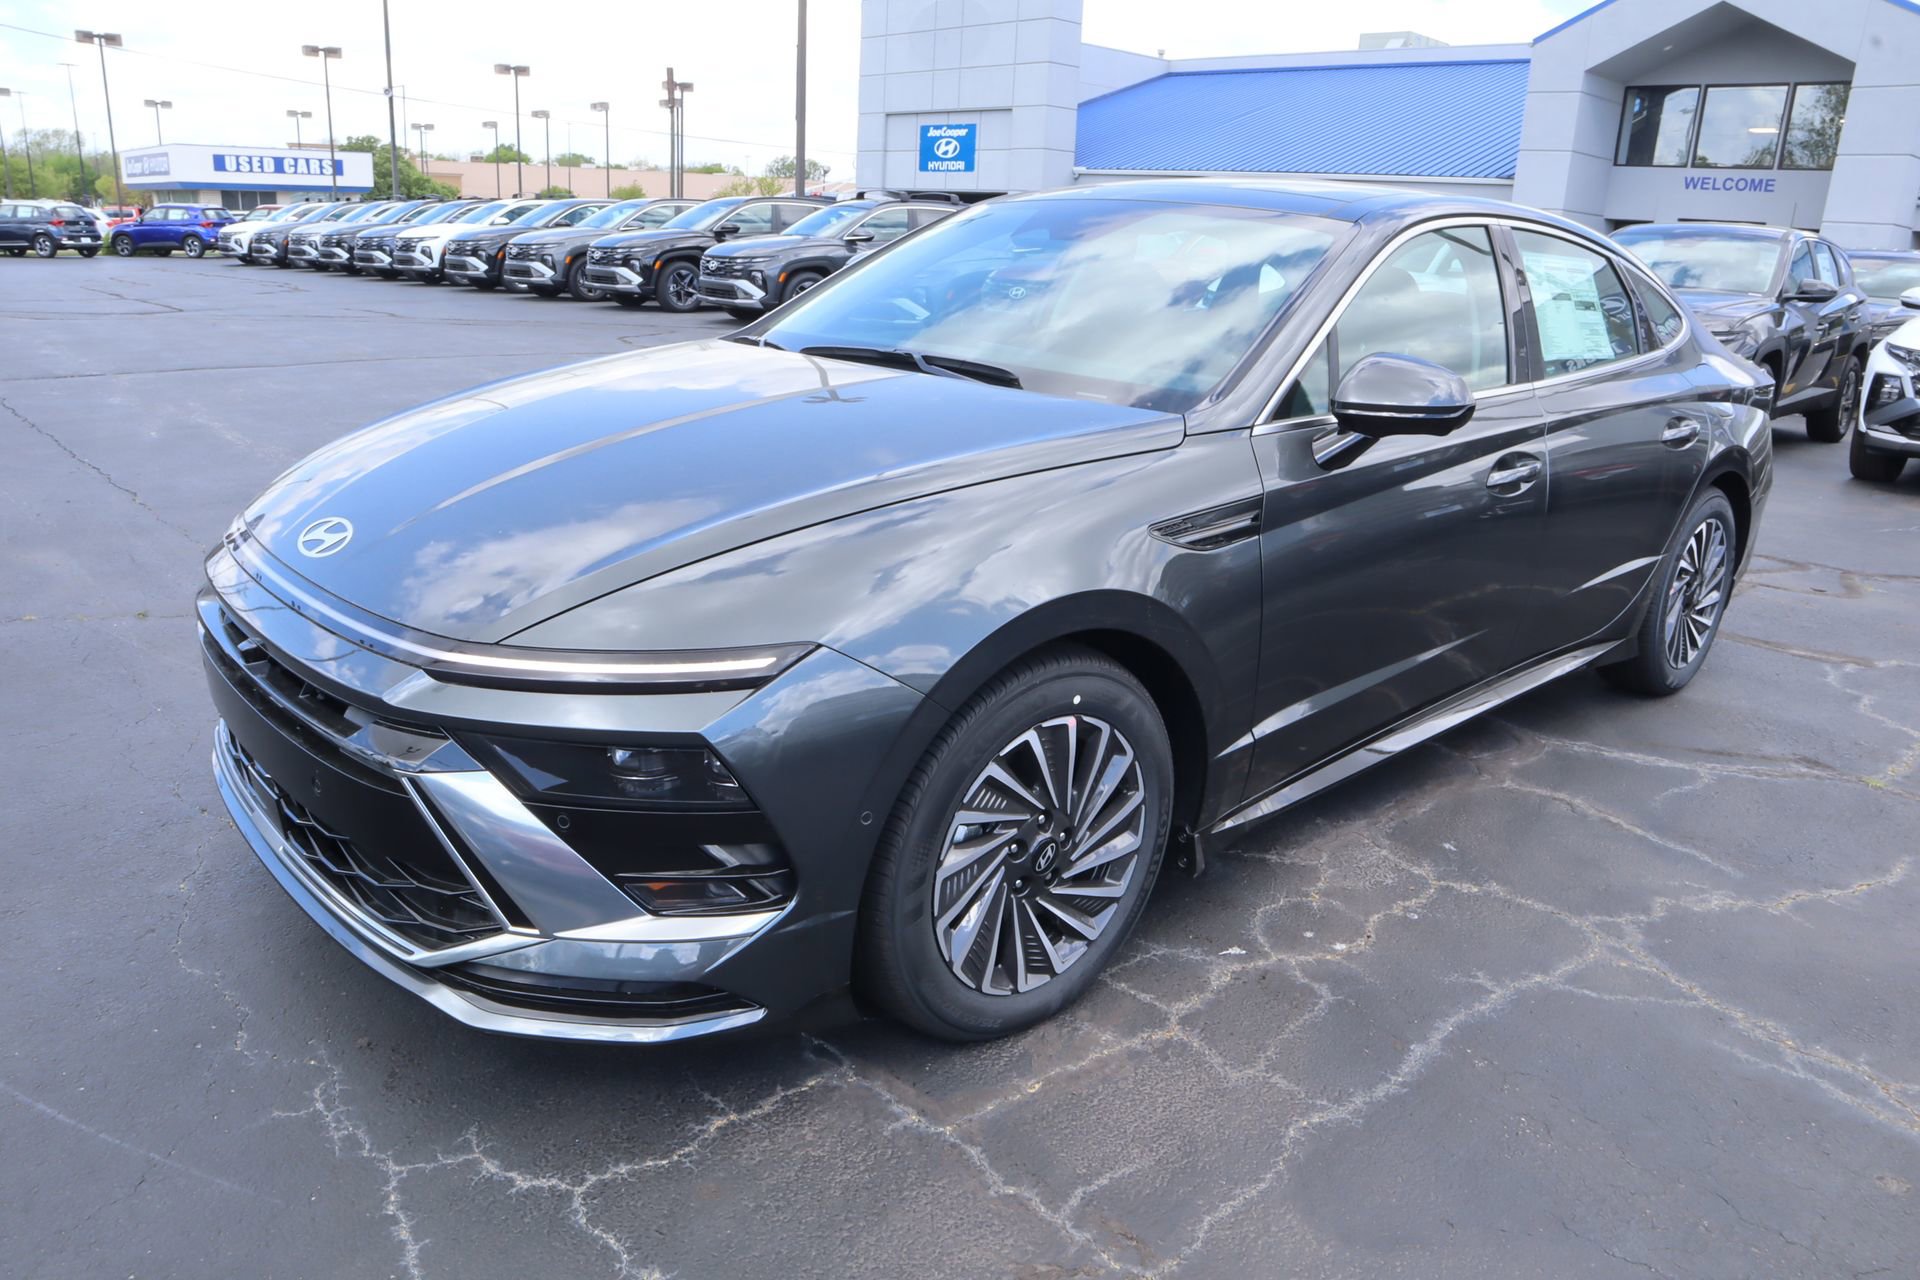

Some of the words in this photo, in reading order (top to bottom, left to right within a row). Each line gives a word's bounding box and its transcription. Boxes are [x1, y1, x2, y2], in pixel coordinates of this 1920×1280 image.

[224, 154, 275, 174] USED
[283, 157, 334, 177] CARS
[928, 161, 965, 170] HYUNDAI
[1684, 175, 1776, 193] WELCOME
